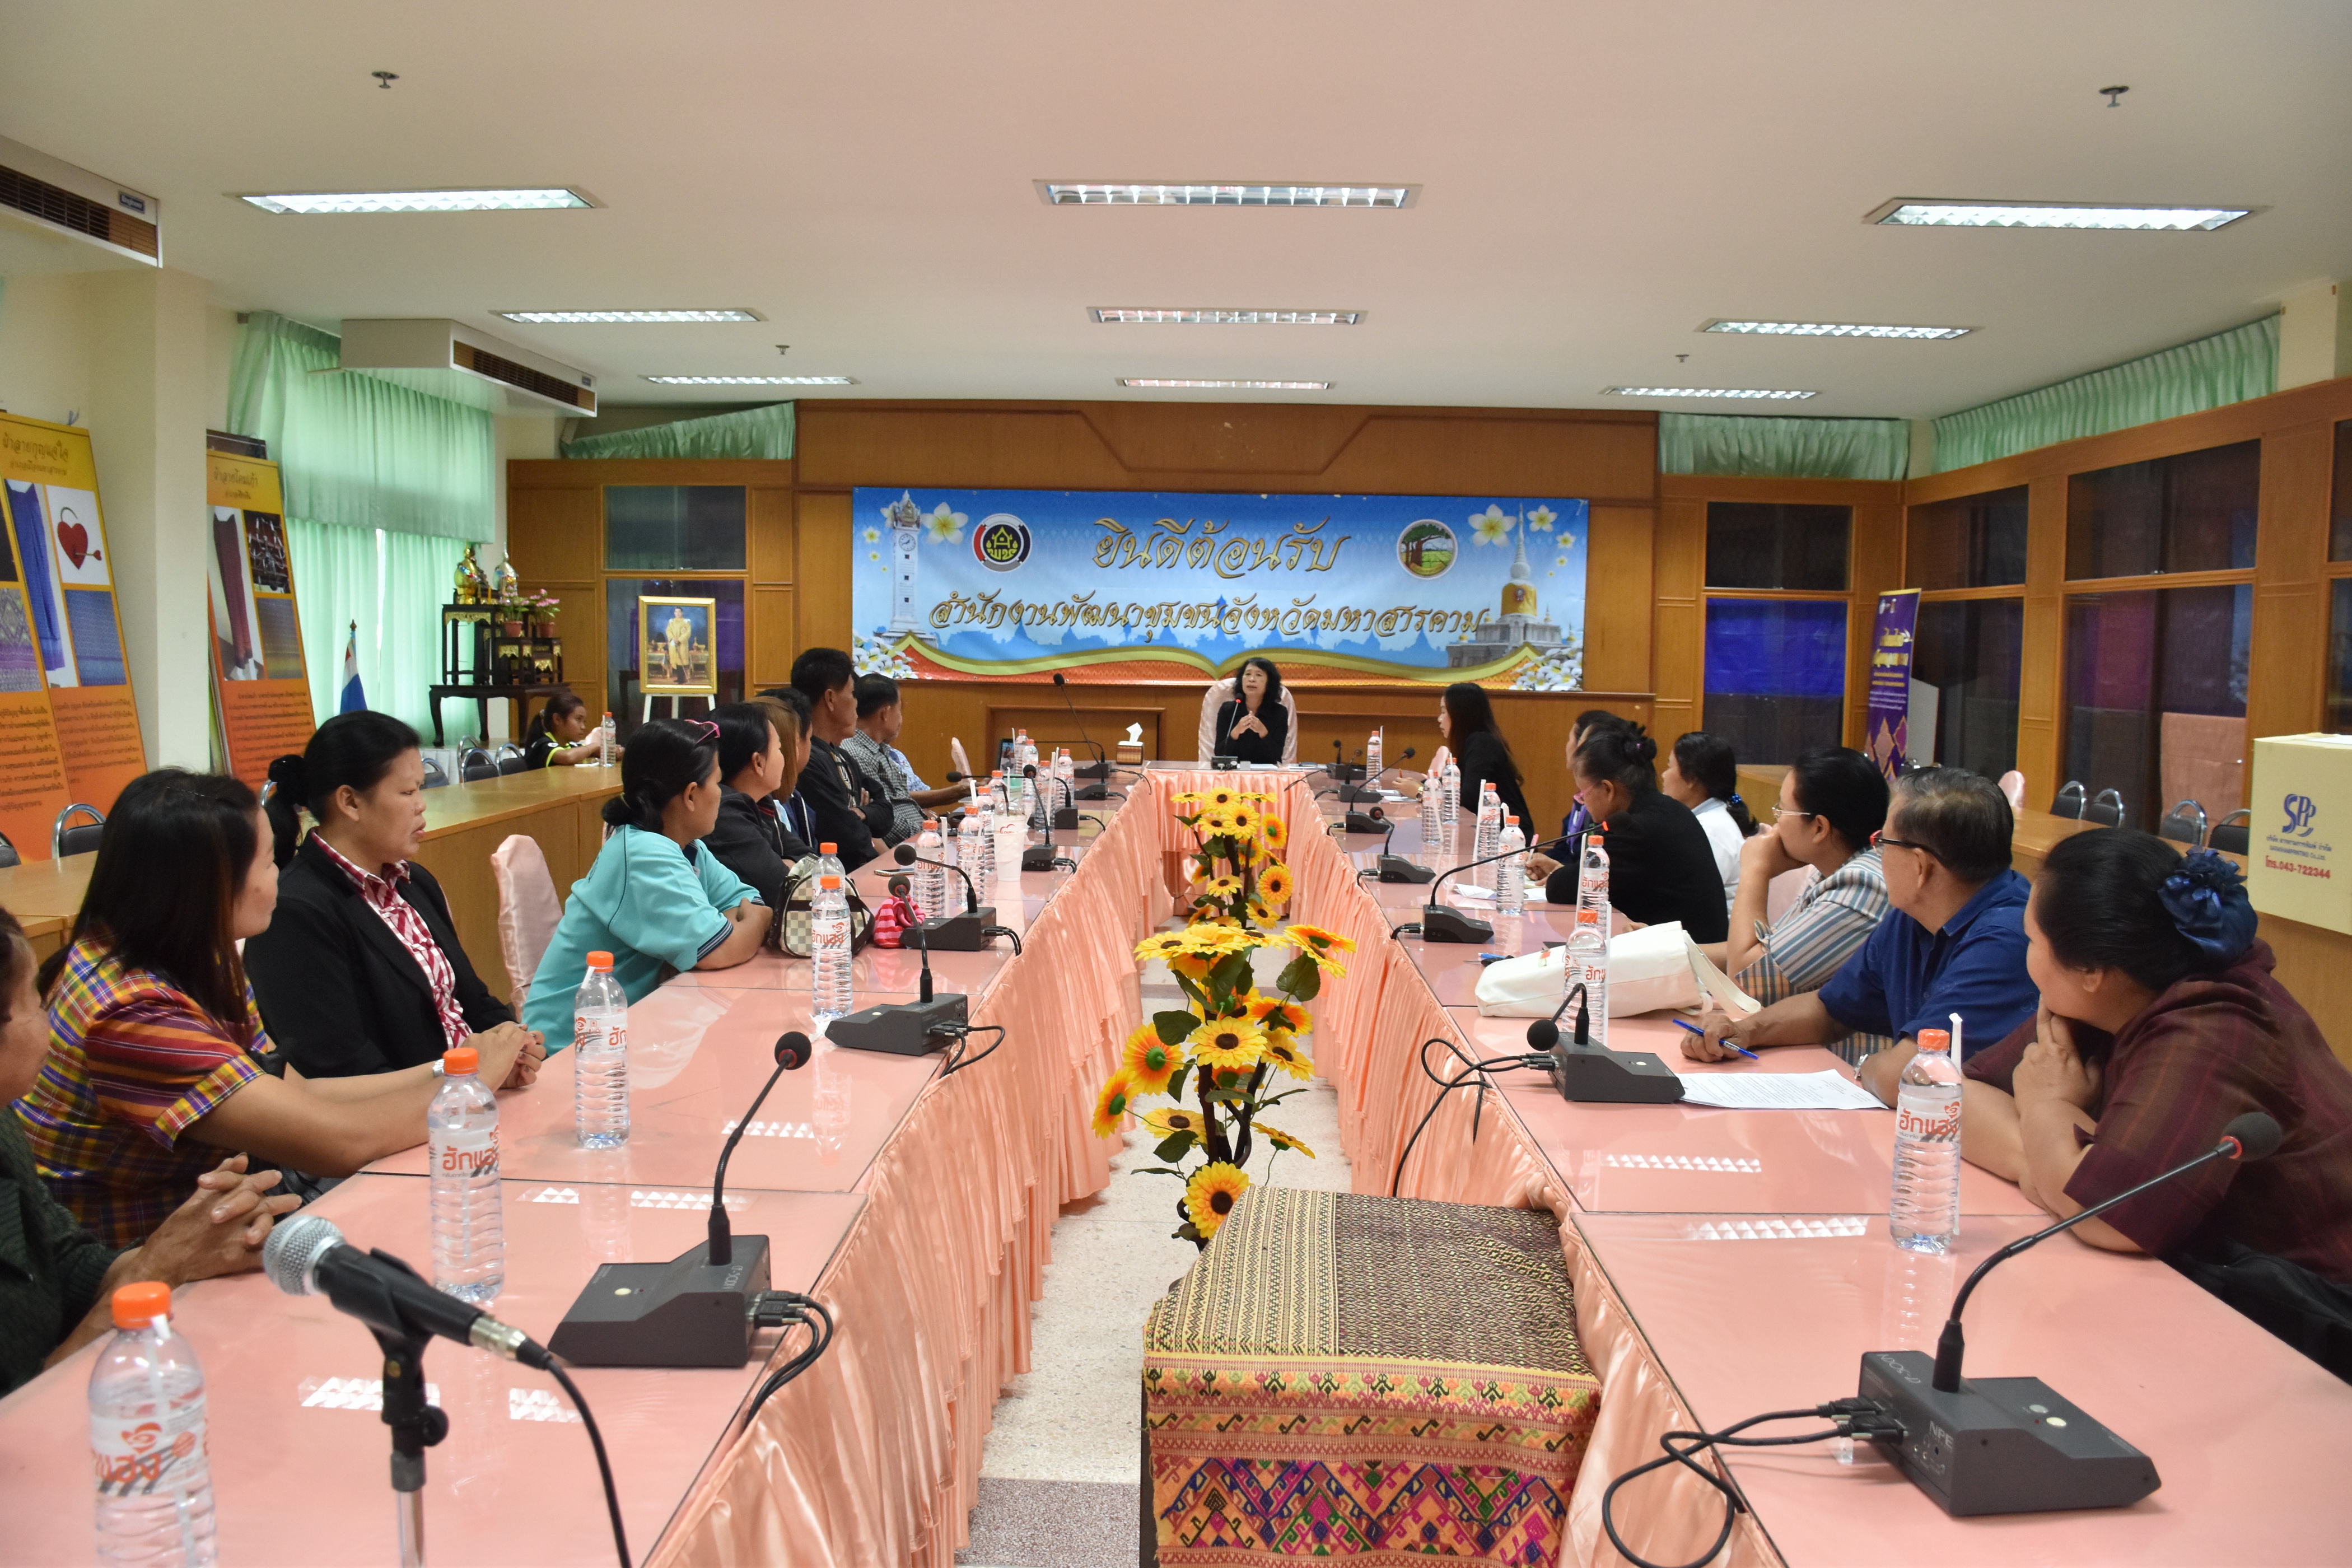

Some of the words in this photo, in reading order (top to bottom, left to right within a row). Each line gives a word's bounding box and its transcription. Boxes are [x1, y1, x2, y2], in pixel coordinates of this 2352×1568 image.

[1092, 515, 1351, 579] ยินดีต้อนรับ
[929, 591, 1491, 643] สำนักงานพัฒนาชุมชนจังหวัดมหาสารคาม
[1899, 1107, 1959, 1132] ฮักแฮง
[1929, 1421, 1954, 1450] NPE
